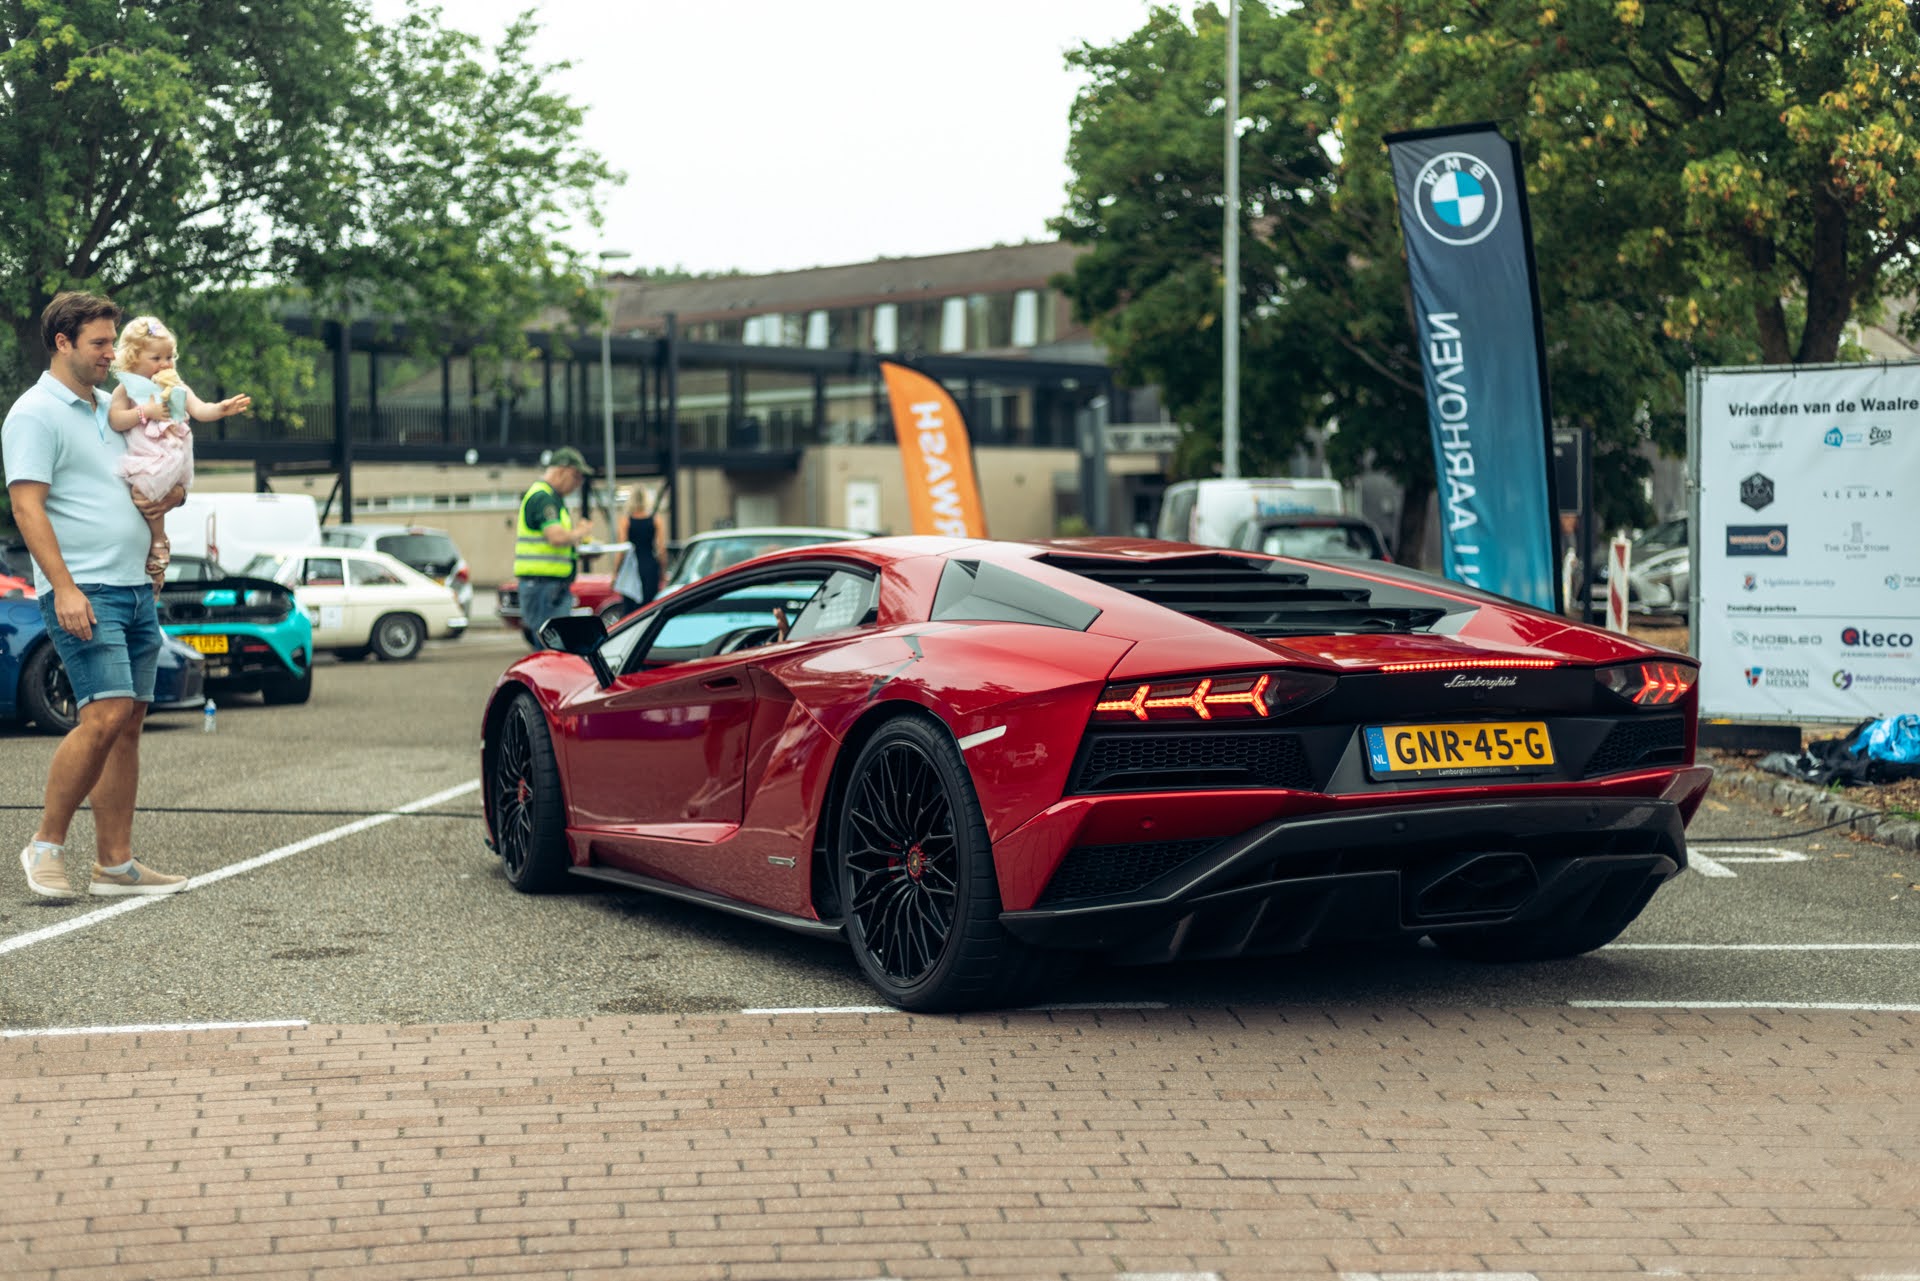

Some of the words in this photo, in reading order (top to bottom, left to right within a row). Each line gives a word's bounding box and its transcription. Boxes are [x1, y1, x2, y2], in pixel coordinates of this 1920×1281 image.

[1728, 402, 1799, 416] Vrienden
[1803, 402, 1831, 414] van
[1836, 399, 1856, 412] de
[1860, 397, 1919, 412] Waalre
[1444, 674, 1518, 689] Lamborghini
[1395, 728, 1545, 764] GNR-45-G
[1373, 754, 1387, 764] NL
[1438, 768, 1472, 776] Lamborghini
